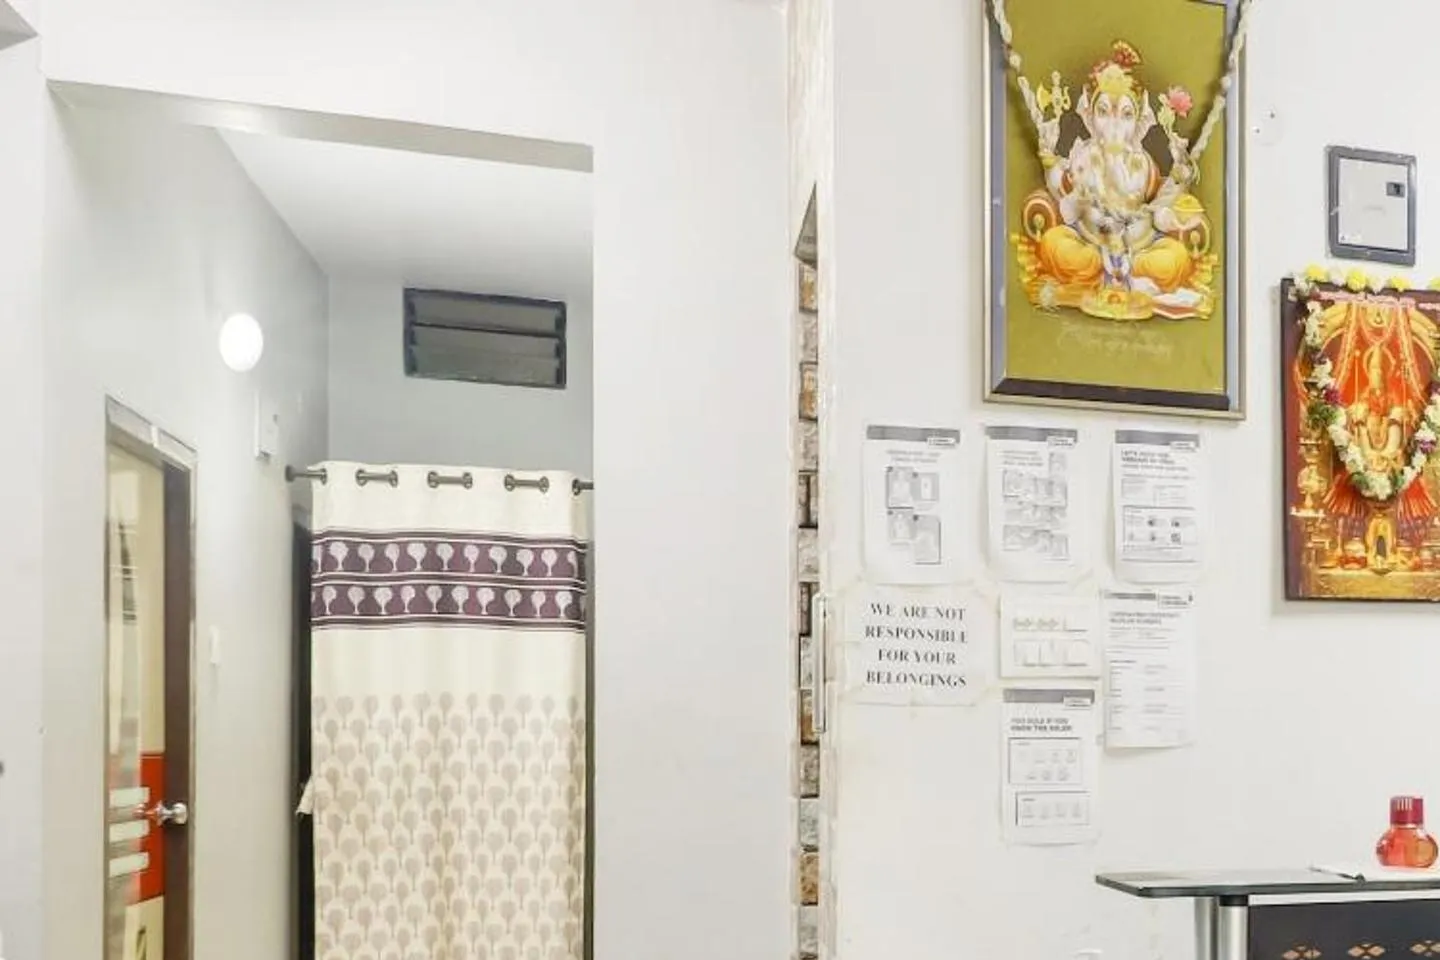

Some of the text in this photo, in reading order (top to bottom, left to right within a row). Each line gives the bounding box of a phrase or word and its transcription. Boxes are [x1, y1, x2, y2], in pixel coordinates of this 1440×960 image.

[870, 602, 966, 621] WE ARE NOT
[865, 625, 968, 643] RESPONSIBLE
[878, 649, 957, 664] FOR YOUR
[867, 670, 966, 687] BELONGINGS
